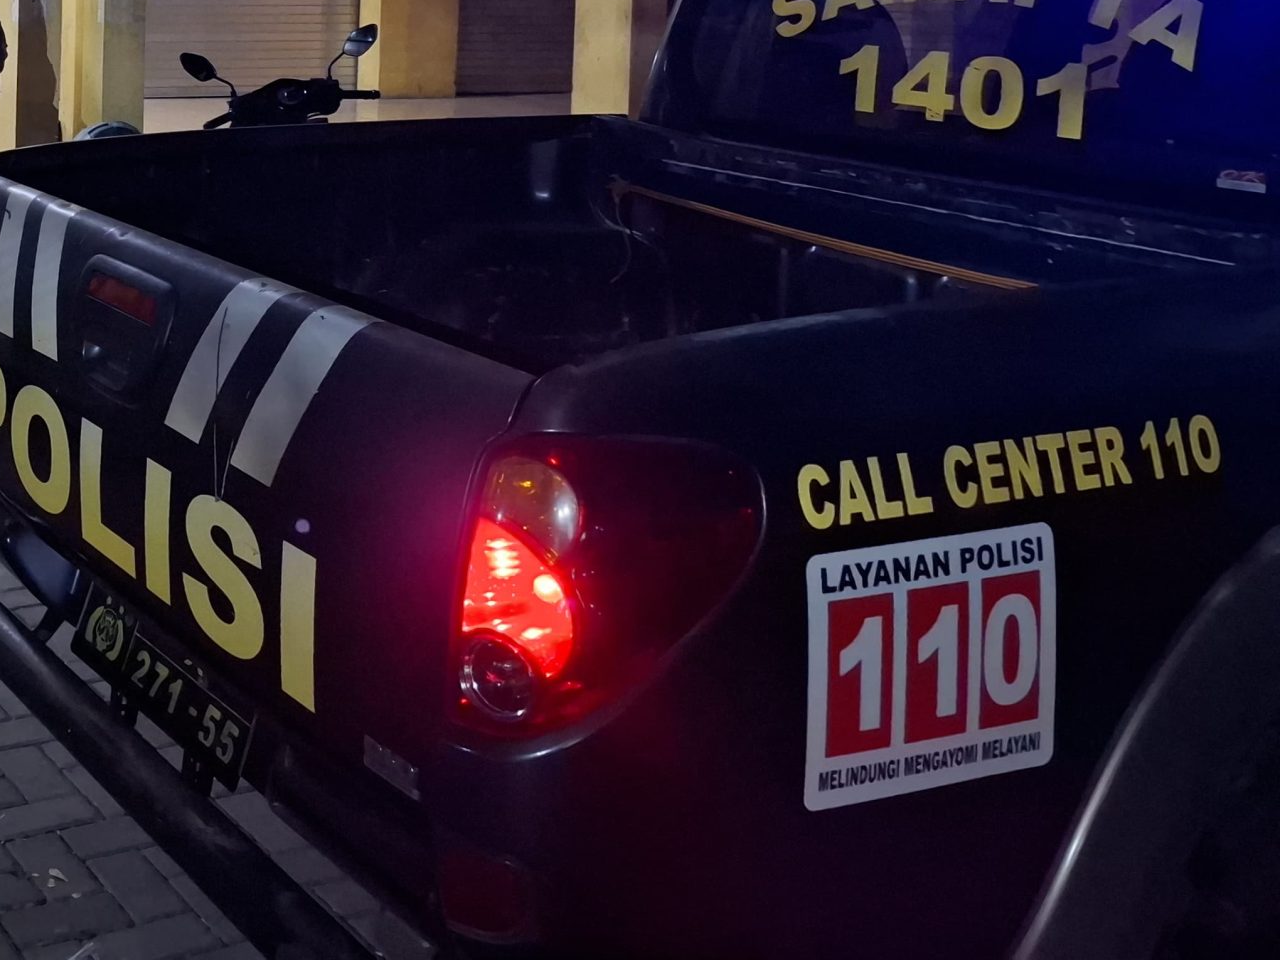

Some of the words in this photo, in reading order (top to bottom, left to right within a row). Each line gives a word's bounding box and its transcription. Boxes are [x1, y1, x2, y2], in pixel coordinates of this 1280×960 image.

[838, 44, 1089, 141] 1401
[797, 451, 934, 530] CALL
[943, 425, 1133, 510] CENTER
[1140, 413, 1221, 481] 110
[820, 550, 951, 595] LAYANAN
[960, 536, 1044, 575] POLISI
[839, 592, 1039, 733] 110
[817, 759, 901, 792] MELINDUNGI
[903, 742, 978, 777] MENGAYOMI
[981, 730, 1042, 761] MELAYANI
